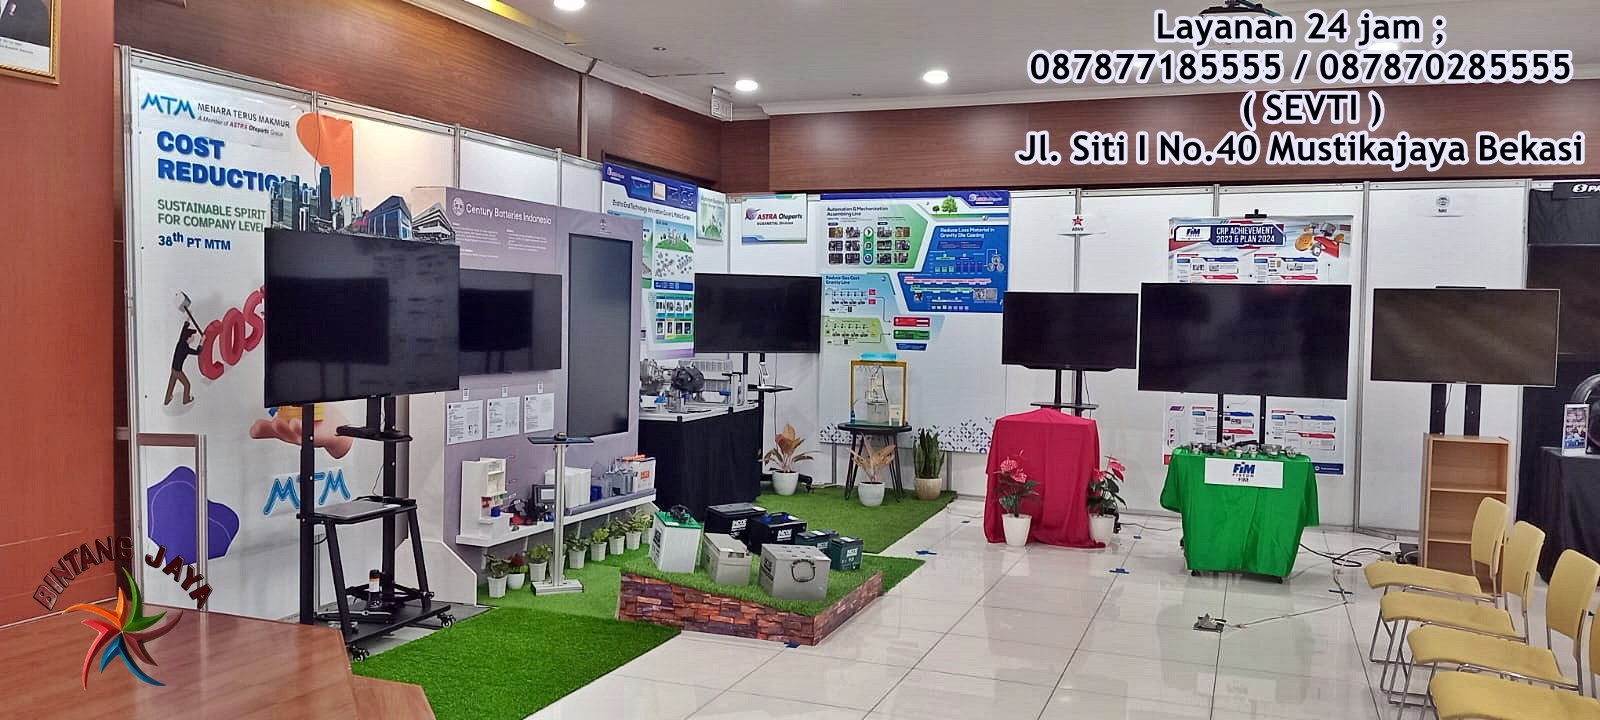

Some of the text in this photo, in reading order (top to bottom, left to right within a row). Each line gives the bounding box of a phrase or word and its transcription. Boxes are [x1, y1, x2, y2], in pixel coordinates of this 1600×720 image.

[141, 92, 195, 119] MTM
[197, 103, 290, 128] MENARA TERUS MAKMUR
[157, 131, 225, 160] COST
[158, 199, 266, 220] SUSTAINABLE SPIRIT
[465, 203, 552, 225] Century Batteries Indonesia
[158, 213, 265, 233] FOR COMPANY LEVEL
[1216, 226, 1273, 235] CRP ACHIEVEMENT
[158, 232, 231, 250] 38th PT MTM
[1216, 235, 1233, 243] 2023
[1239, 235, 1257, 243] PLAN
[1258, 234, 1275, 243] 2024
